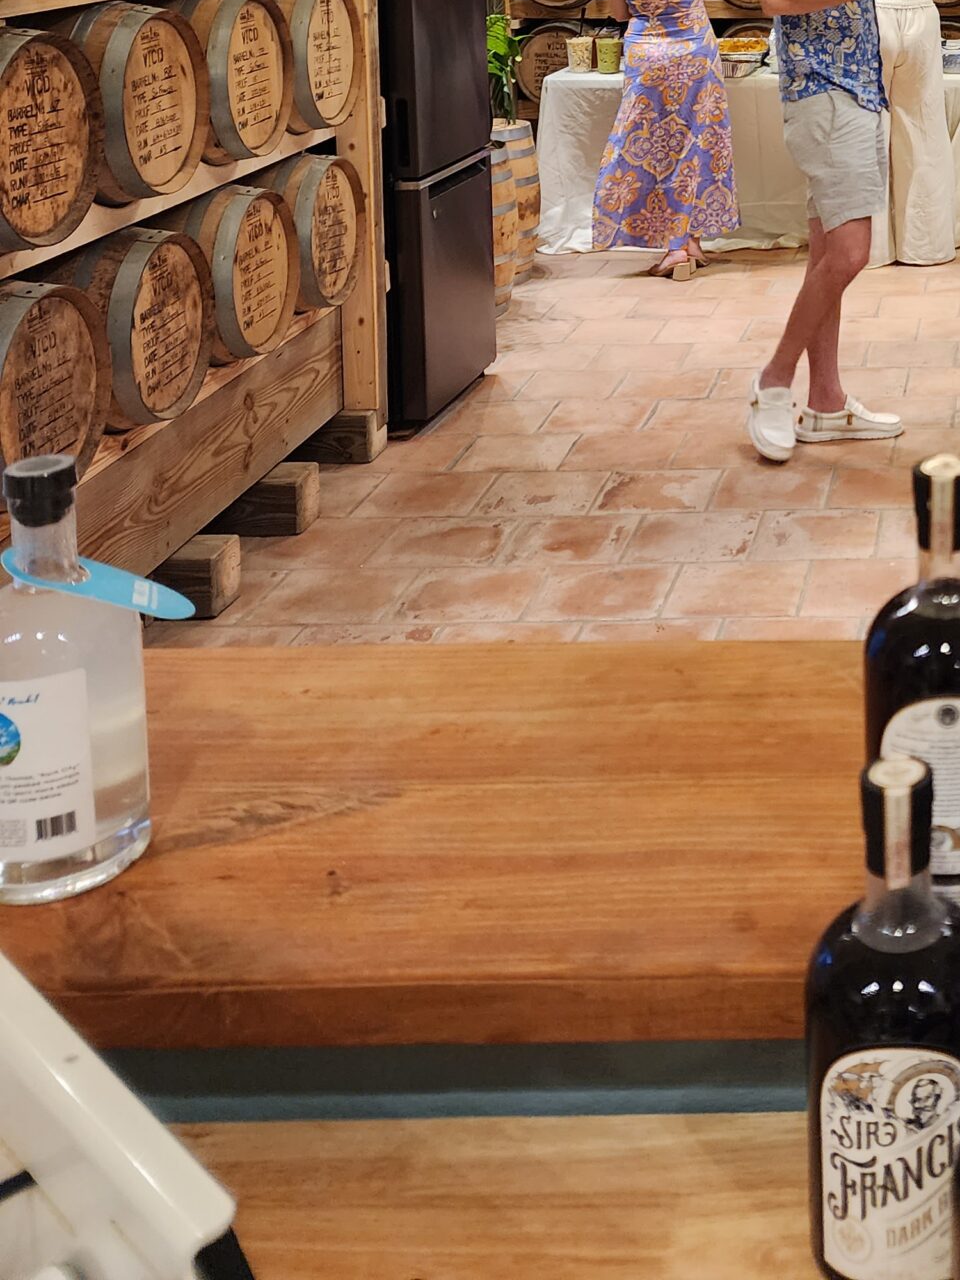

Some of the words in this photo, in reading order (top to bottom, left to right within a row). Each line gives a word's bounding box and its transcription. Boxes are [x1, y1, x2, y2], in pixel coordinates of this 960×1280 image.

[24, 75, 51, 97] VICD
[8, 123, 28, 140] TYPE
[9, 139, 31, 156] PROOF
[9, 157, 28, 175] DATE
[10, 176, 26, 192] RUN
[11, 192, 30, 209] CHAR
[830, 1115, 897, 1150] SIR
[886, 1206, 934, 1249] DARK
